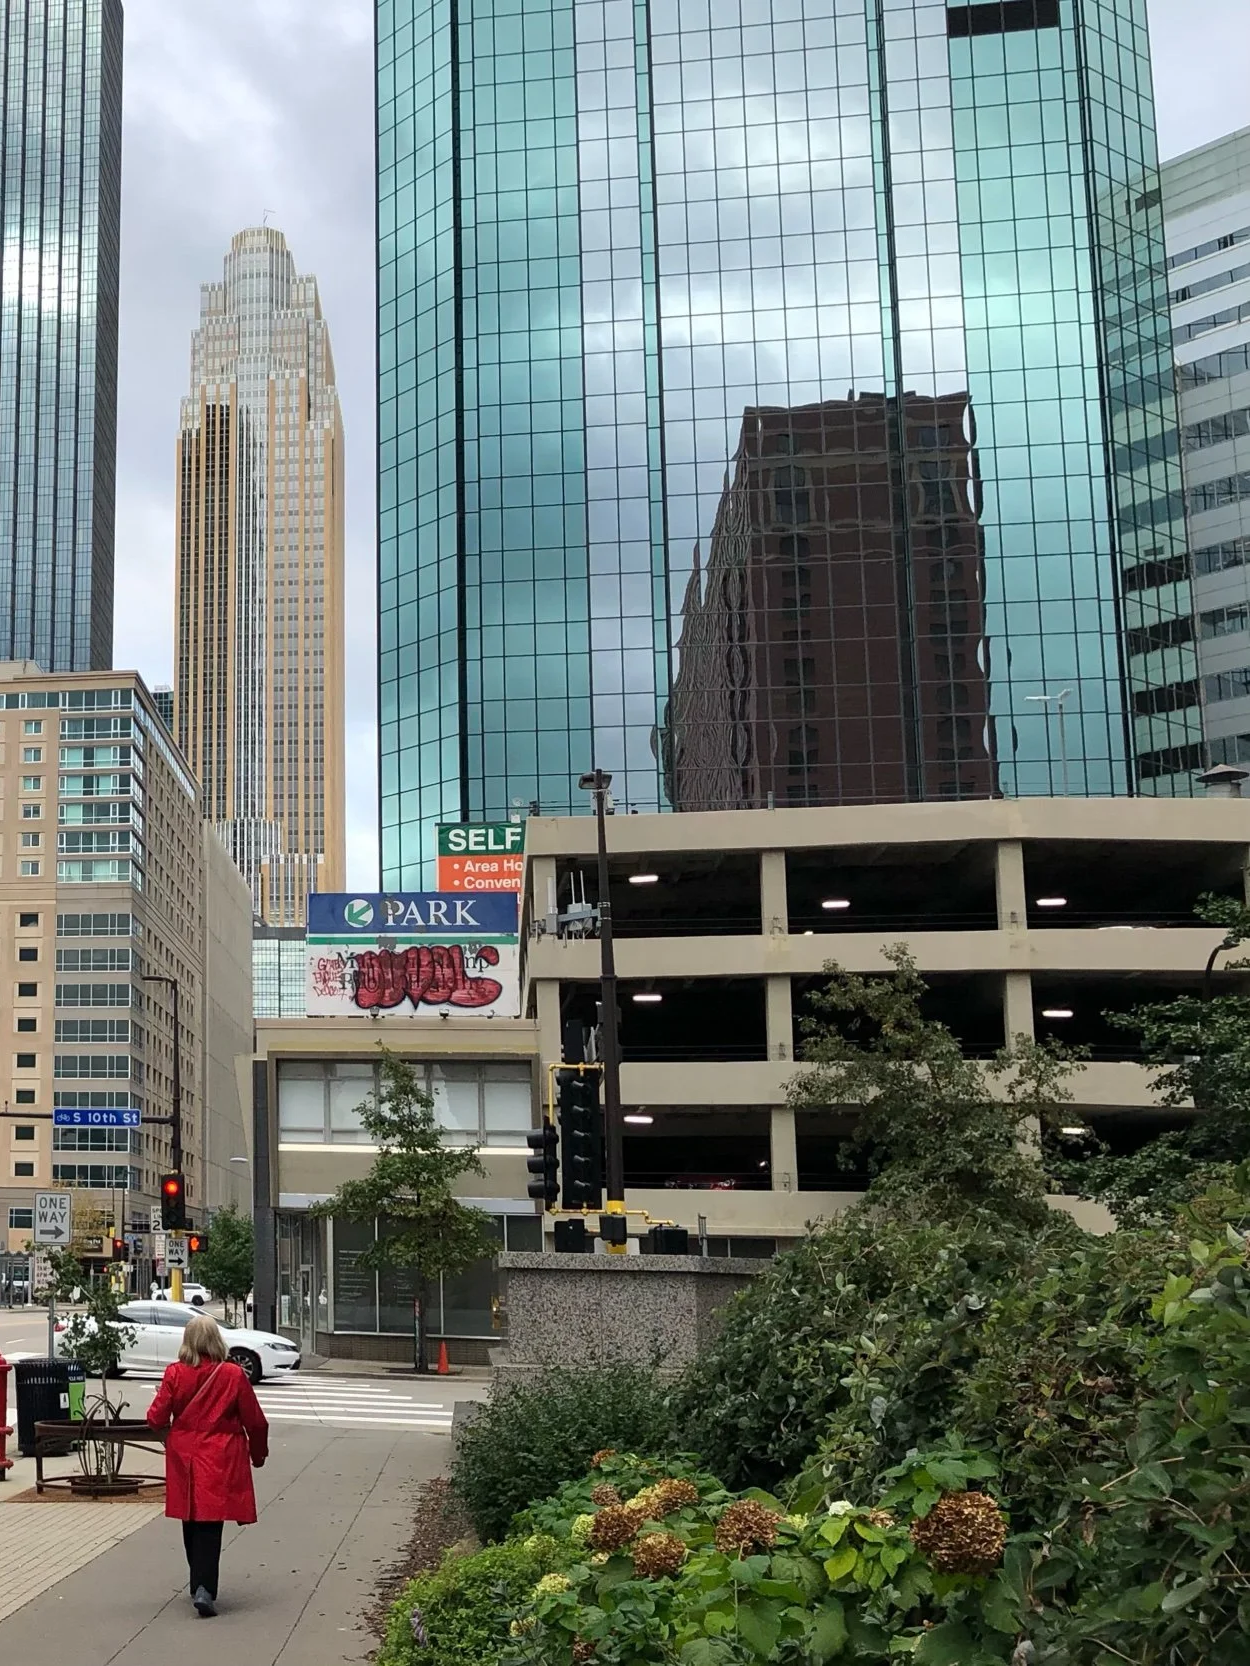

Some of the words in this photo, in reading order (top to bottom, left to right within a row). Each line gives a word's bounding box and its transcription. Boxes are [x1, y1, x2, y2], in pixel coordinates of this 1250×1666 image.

[448, 828, 522, 851] SELF
[464, 860, 499, 873] Area
[464, 876, 521, 889] Conven
[385, 899, 481, 926] PARK
[73, 1112, 81, 1123] S
[88, 1112, 117, 1123] 10th
[123, 1113, 138, 1124] St
[40, 1197, 67, 1210] ONE
[38, 1211, 67, 1224] WAY
[168, 1240, 185, 1248] ONE
[168, 1248, 185, 1256] WAY
